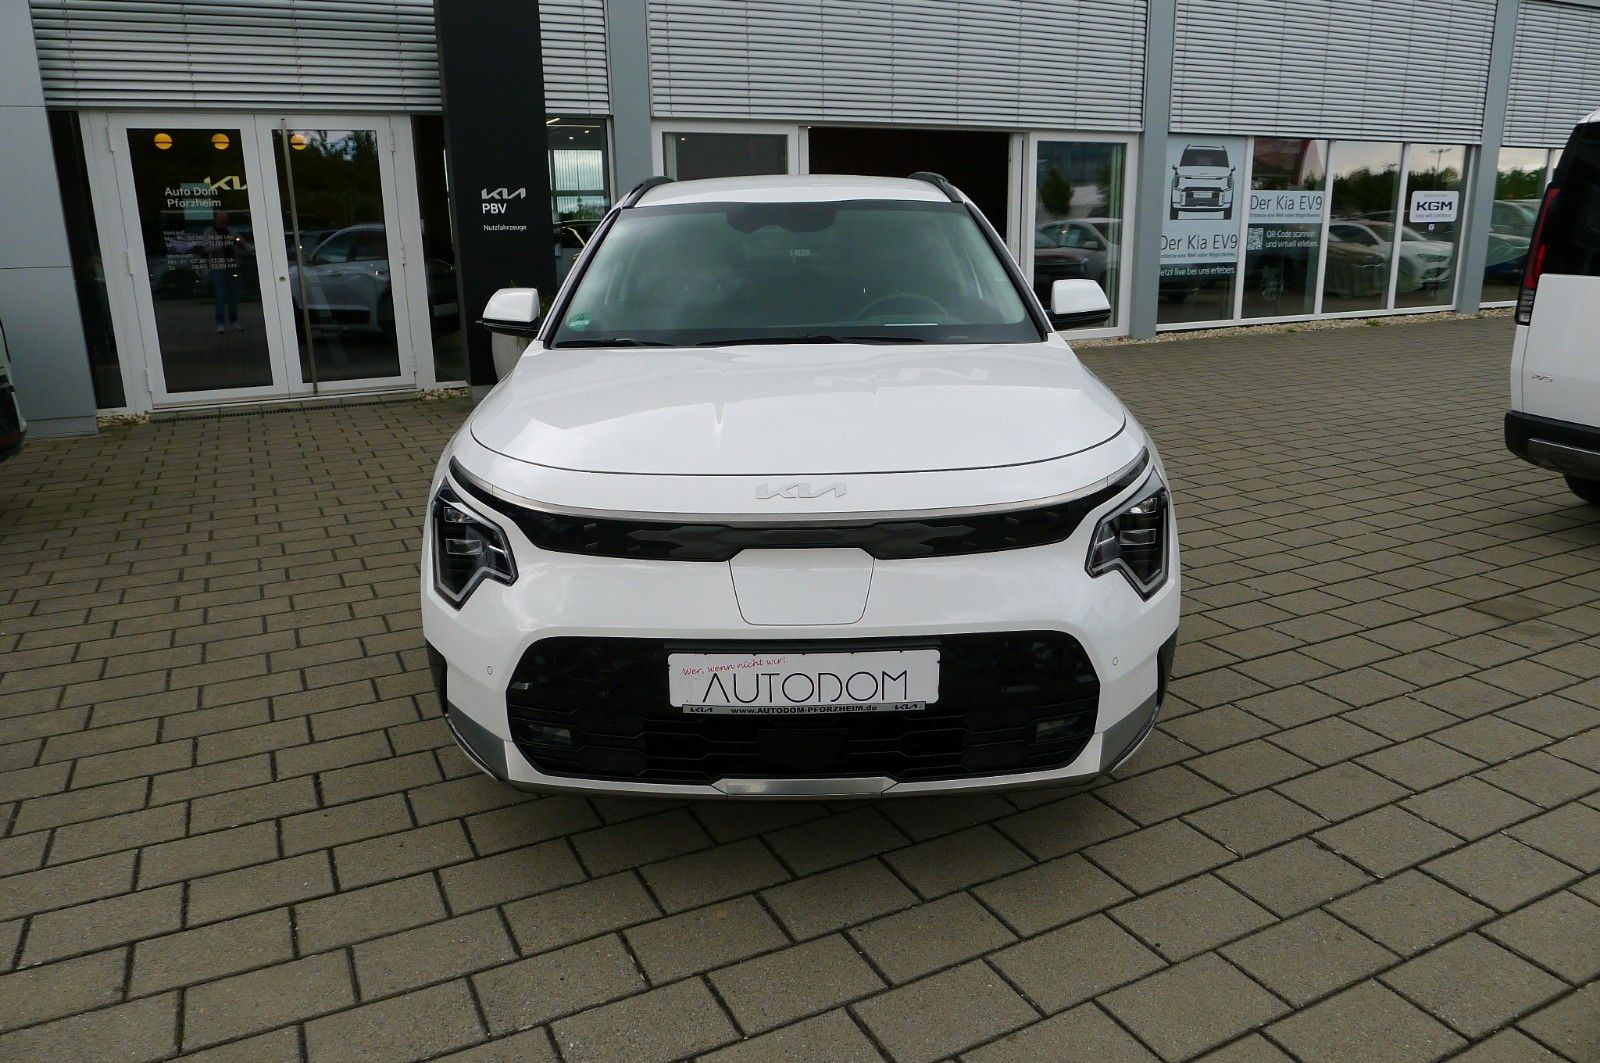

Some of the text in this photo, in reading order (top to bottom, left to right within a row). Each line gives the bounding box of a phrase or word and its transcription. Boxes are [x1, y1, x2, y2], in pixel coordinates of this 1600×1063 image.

[203, 175, 248, 190] KI
[164, 187, 218, 196] Auto Dom
[481, 187, 527, 199] KIA
[167, 198, 222, 208] Pforzheim
[1250, 195, 1323, 210] Der Kia EV9
[1416, 201, 1453, 211] KGM
[482, 203, 507, 214] PBV
[483, 224, 527, 232] Nutzfahrzeuge
[1266, 230, 1291, 238] QR-Code
[1160, 234, 1238, 250] Der Kia EV9
[1174, 266, 1185, 275] live
[1187, 265, 1198, 275] bei
[1198, 267, 1210, 275] uns
[756, 480, 847, 499] KIA
[683, 667, 704, 676] Wer,
[708, 664, 735, 673] wenn
[737, 658, 763, 669] nicht
[702, 670, 907, 703] AUTODOM
[730, 705, 878, 714] www.AUTODOM-PFORZHEIM.de
